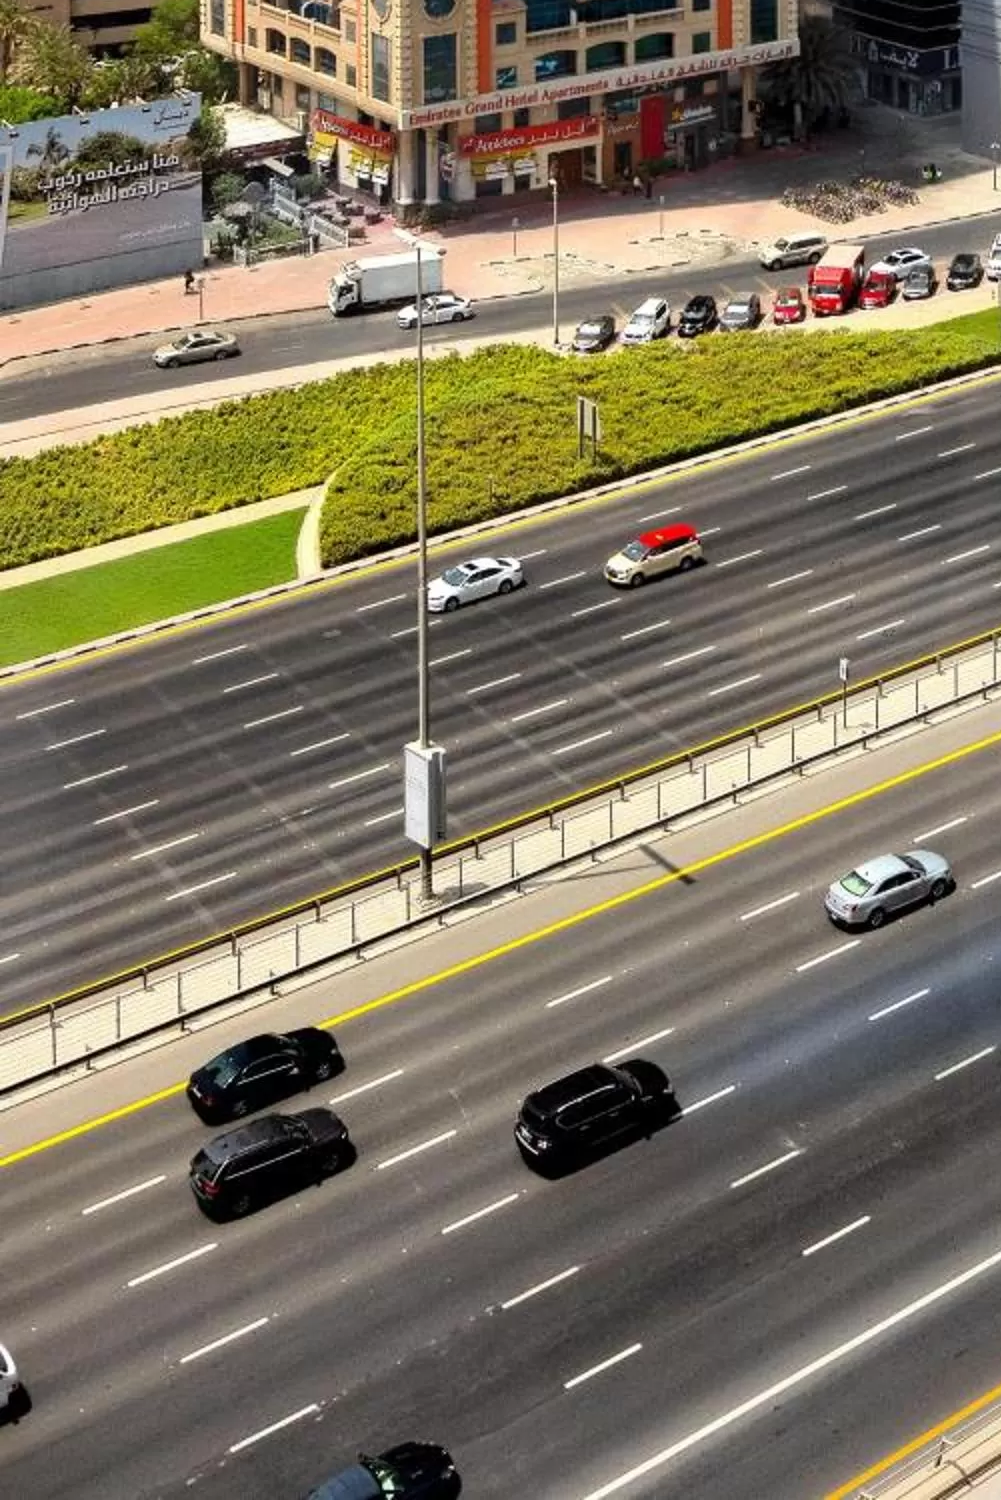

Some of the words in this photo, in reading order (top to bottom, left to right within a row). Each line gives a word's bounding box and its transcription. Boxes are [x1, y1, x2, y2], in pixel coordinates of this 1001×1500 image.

[409, 107, 462, 125] Emirates
[465, 98, 503, 114] Grand
[505, 90, 538, 108] Hotel
[541, 80, 609, 101] Apartments
[153, 153, 179, 169] هنا
[38, 169, 82, 193] ركوب
